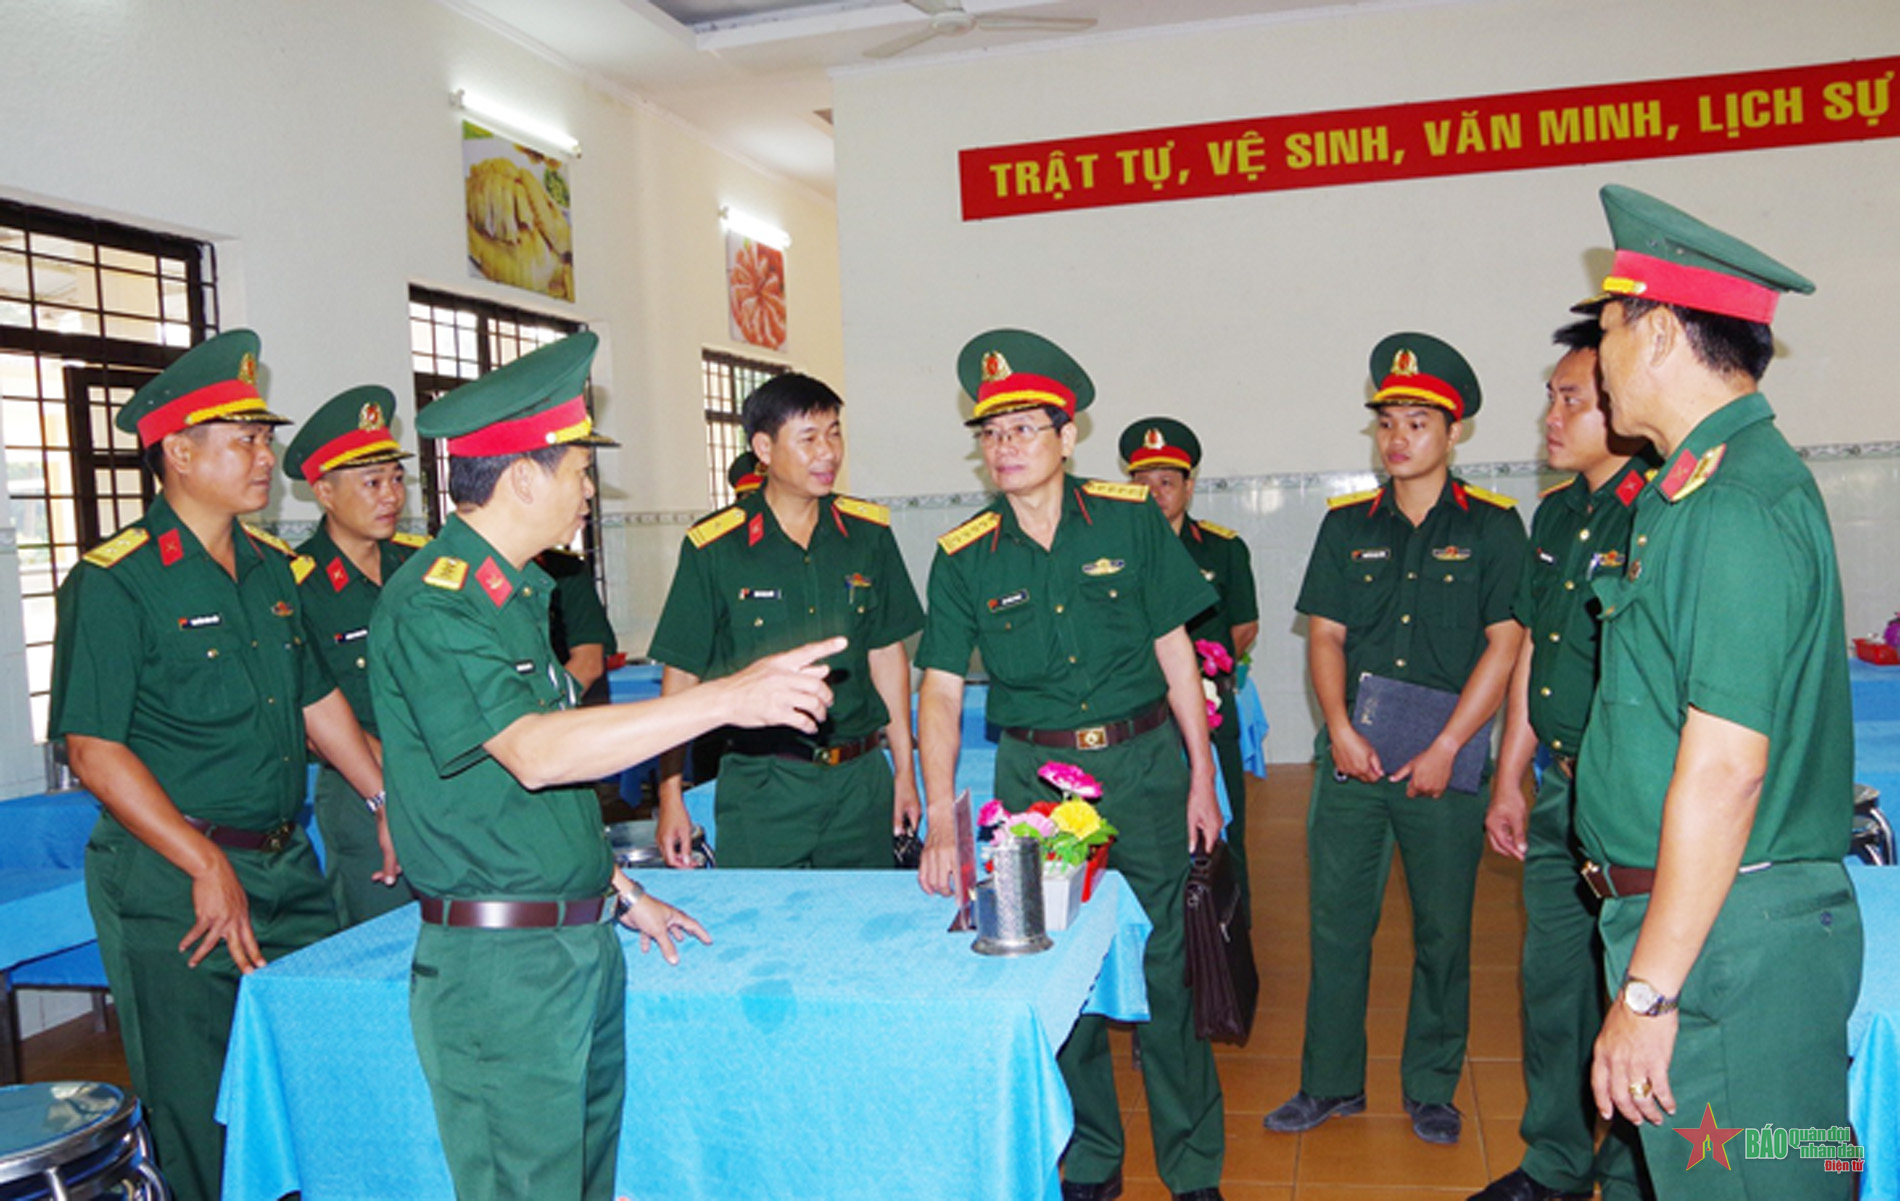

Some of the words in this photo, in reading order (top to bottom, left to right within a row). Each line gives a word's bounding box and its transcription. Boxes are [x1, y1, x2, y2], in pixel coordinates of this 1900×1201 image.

[990, 150, 1099, 200] TRẬT
[1116, 140, 1190, 190] TỰ,
[1208, 130, 1266, 181] VỆ
[1285, 126, 1405, 169] SINH,
[1423, 110, 1522, 157] VĂN
[1539, 100, 1680, 147] MINH,
[1699, 87, 1803, 138] LỊCH
[1823, 71, 1895, 126] SỰ
